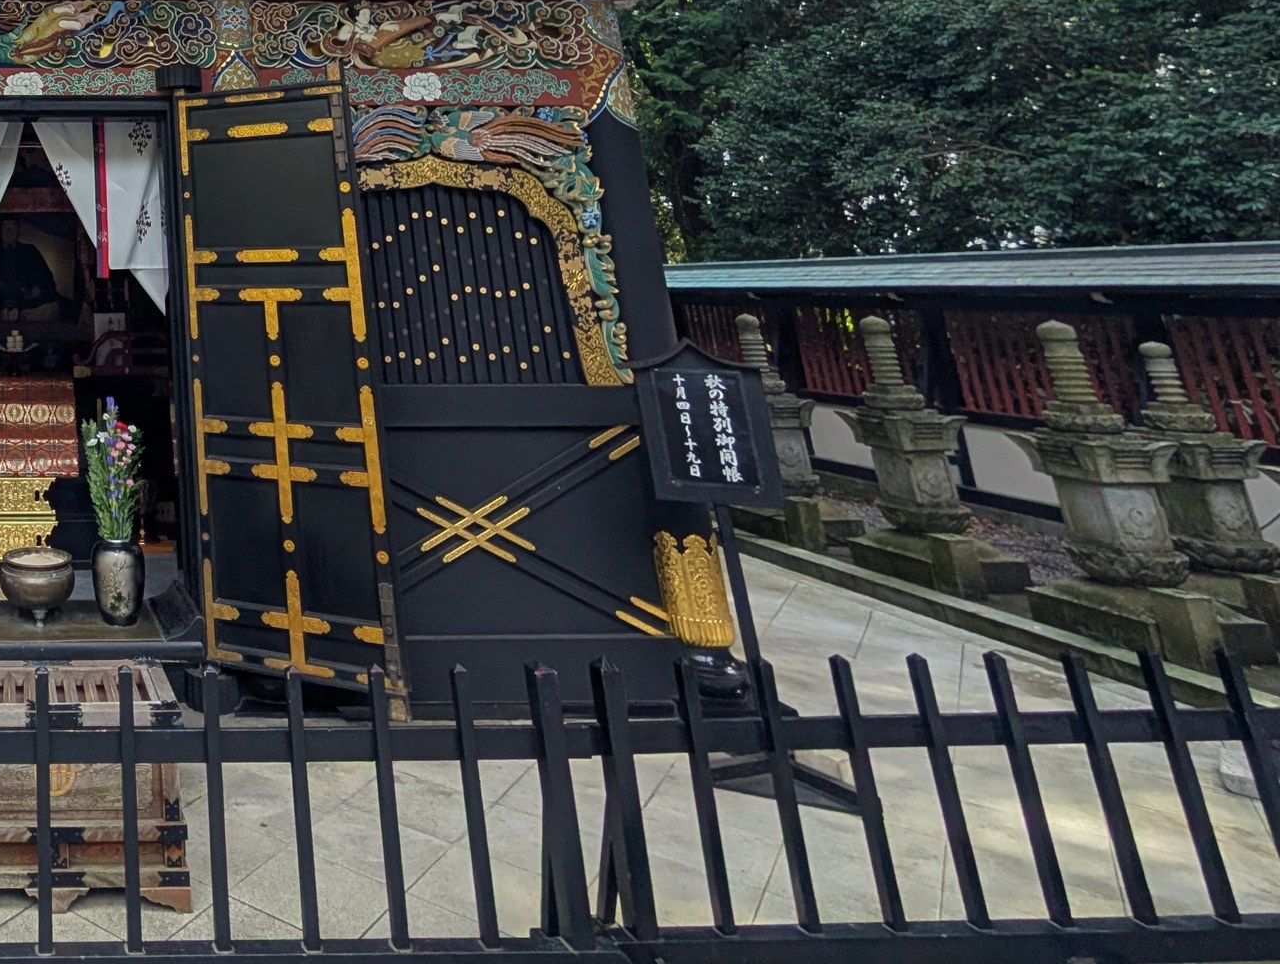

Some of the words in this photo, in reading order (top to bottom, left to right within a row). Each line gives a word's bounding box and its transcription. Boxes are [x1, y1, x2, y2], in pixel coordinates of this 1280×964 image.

[704, 374, 745, 483] 秋の特別御開帳
